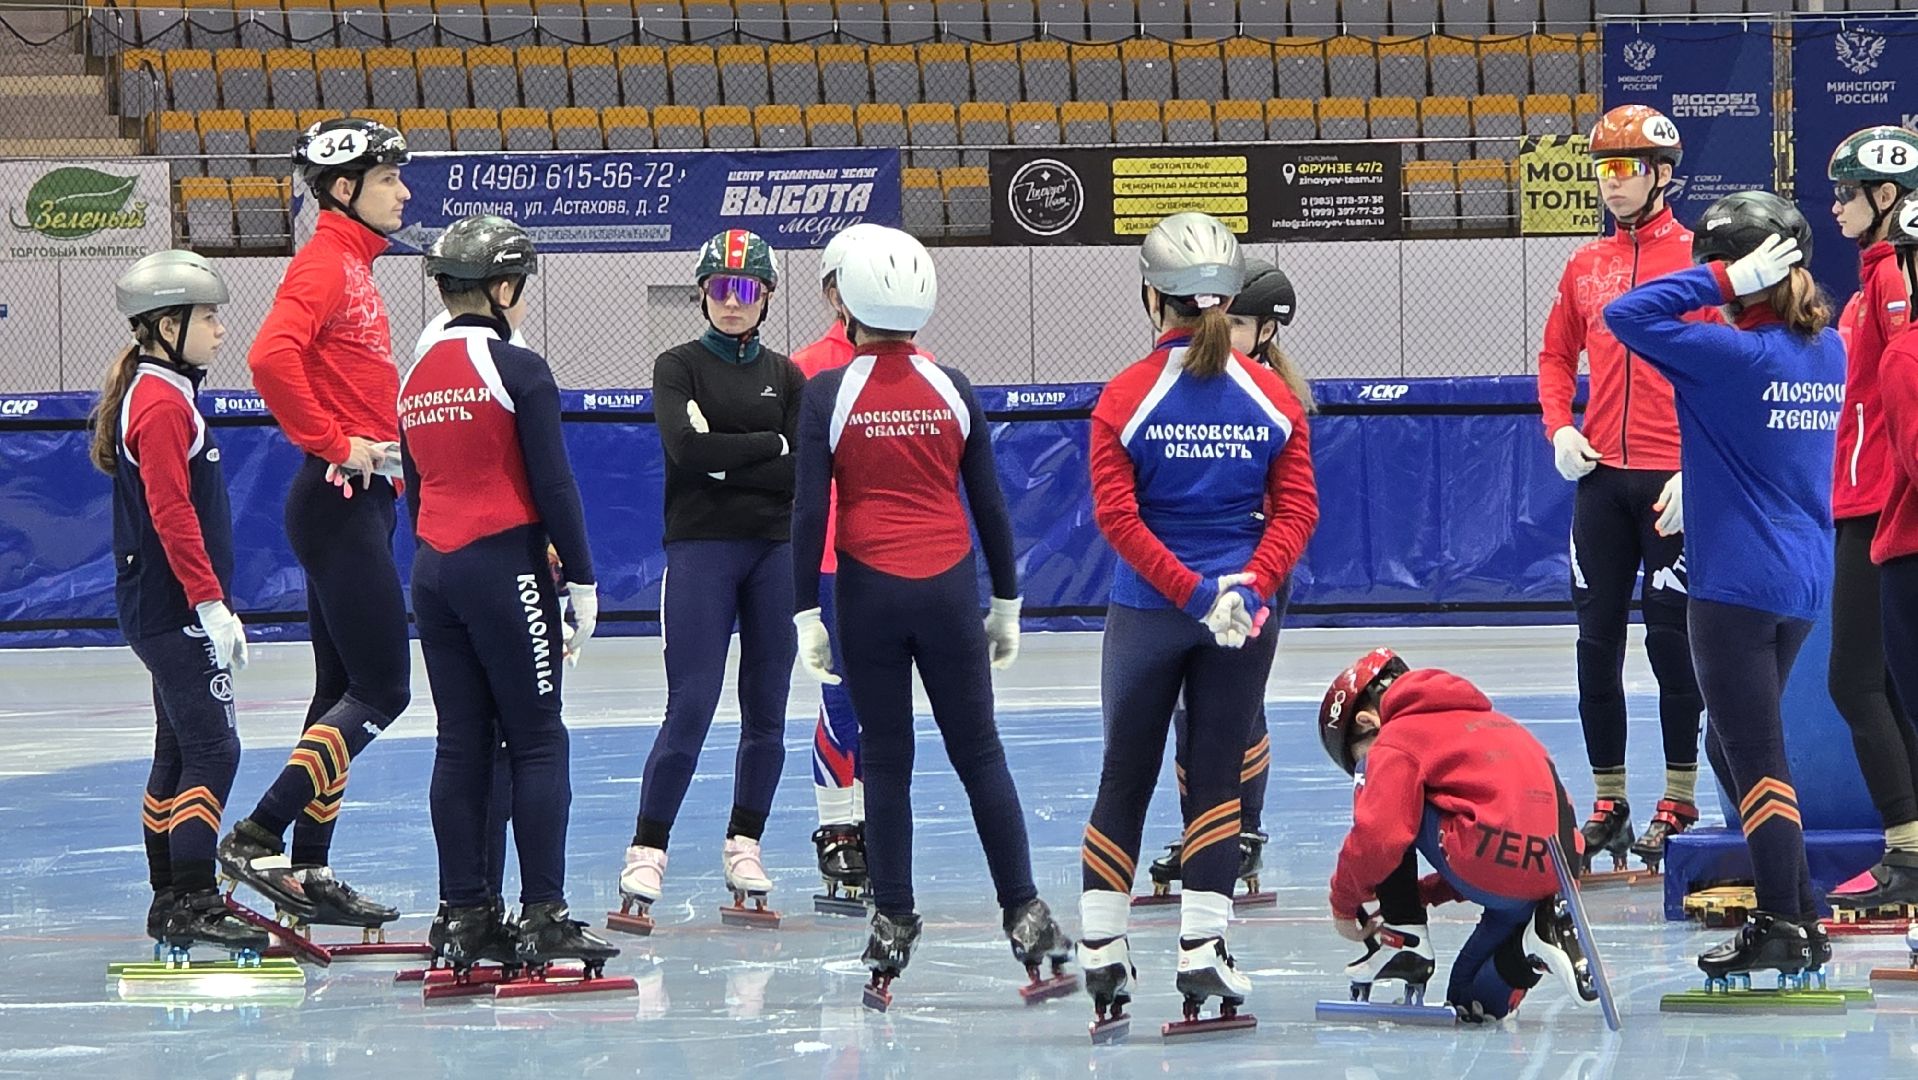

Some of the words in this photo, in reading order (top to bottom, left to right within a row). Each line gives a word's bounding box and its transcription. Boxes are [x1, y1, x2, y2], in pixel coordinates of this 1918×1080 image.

[1618, 75, 1662, 83] МИНСПОРТ
[1826, 81, 1897, 92] МИНСПОРТ
[1835, 93, 1889, 104] РОССИИ
[1653, 121, 1676, 140] 48
[320, 134, 356, 158] 34
[1871, 144, 1907, 166] 18
[727, 171, 764, 181] ЦЕНТР
[767, 169, 837, 181] РЕКЛАМНЫХ
[841, 168, 878, 179] УСЛУГ
[1298, 163, 1353, 174] ФРУНЗЕ
[1355, 161, 1383, 174] 47/2
[448, 164, 463, 190] 8
[472, 163, 537, 191] (496)
[546, 162, 675, 189] 615-56-72
[1298, 175, 1383, 186] zinovyev-team.ru
[1121, 182, 1177, 190] РЕМОНТНАЯ
[1179, 181, 1240, 189] МАСТЕРСКАЯ
[442, 198, 518, 218] Коломна,
[524, 203, 547, 219] ул.
[552, 197, 630, 216] Астахова,
[635, 200, 652, 216] д.
[658, 194, 670, 214] 2
[720, 183, 874, 216] ВЫСОТА
[34, 200, 148, 230] Зеленый
[11, 246, 77, 258] ТОРГОВЫЙ
[80, 245, 147, 257] КОМПЛЕКС
[597, 394, 644, 406] OLYMP
[1020, 392, 1066, 403] OLYMP
[848, 409, 952, 426] МОСКОВСКАЯ
[1766, 409, 1841, 430] REGION
[865, 423, 941, 438] ОБЛАСТЬ
[1145, 424, 1269, 441] МОСКОВСКАЯ
[1165, 442, 1252, 459] ОБЛАСТЬ
